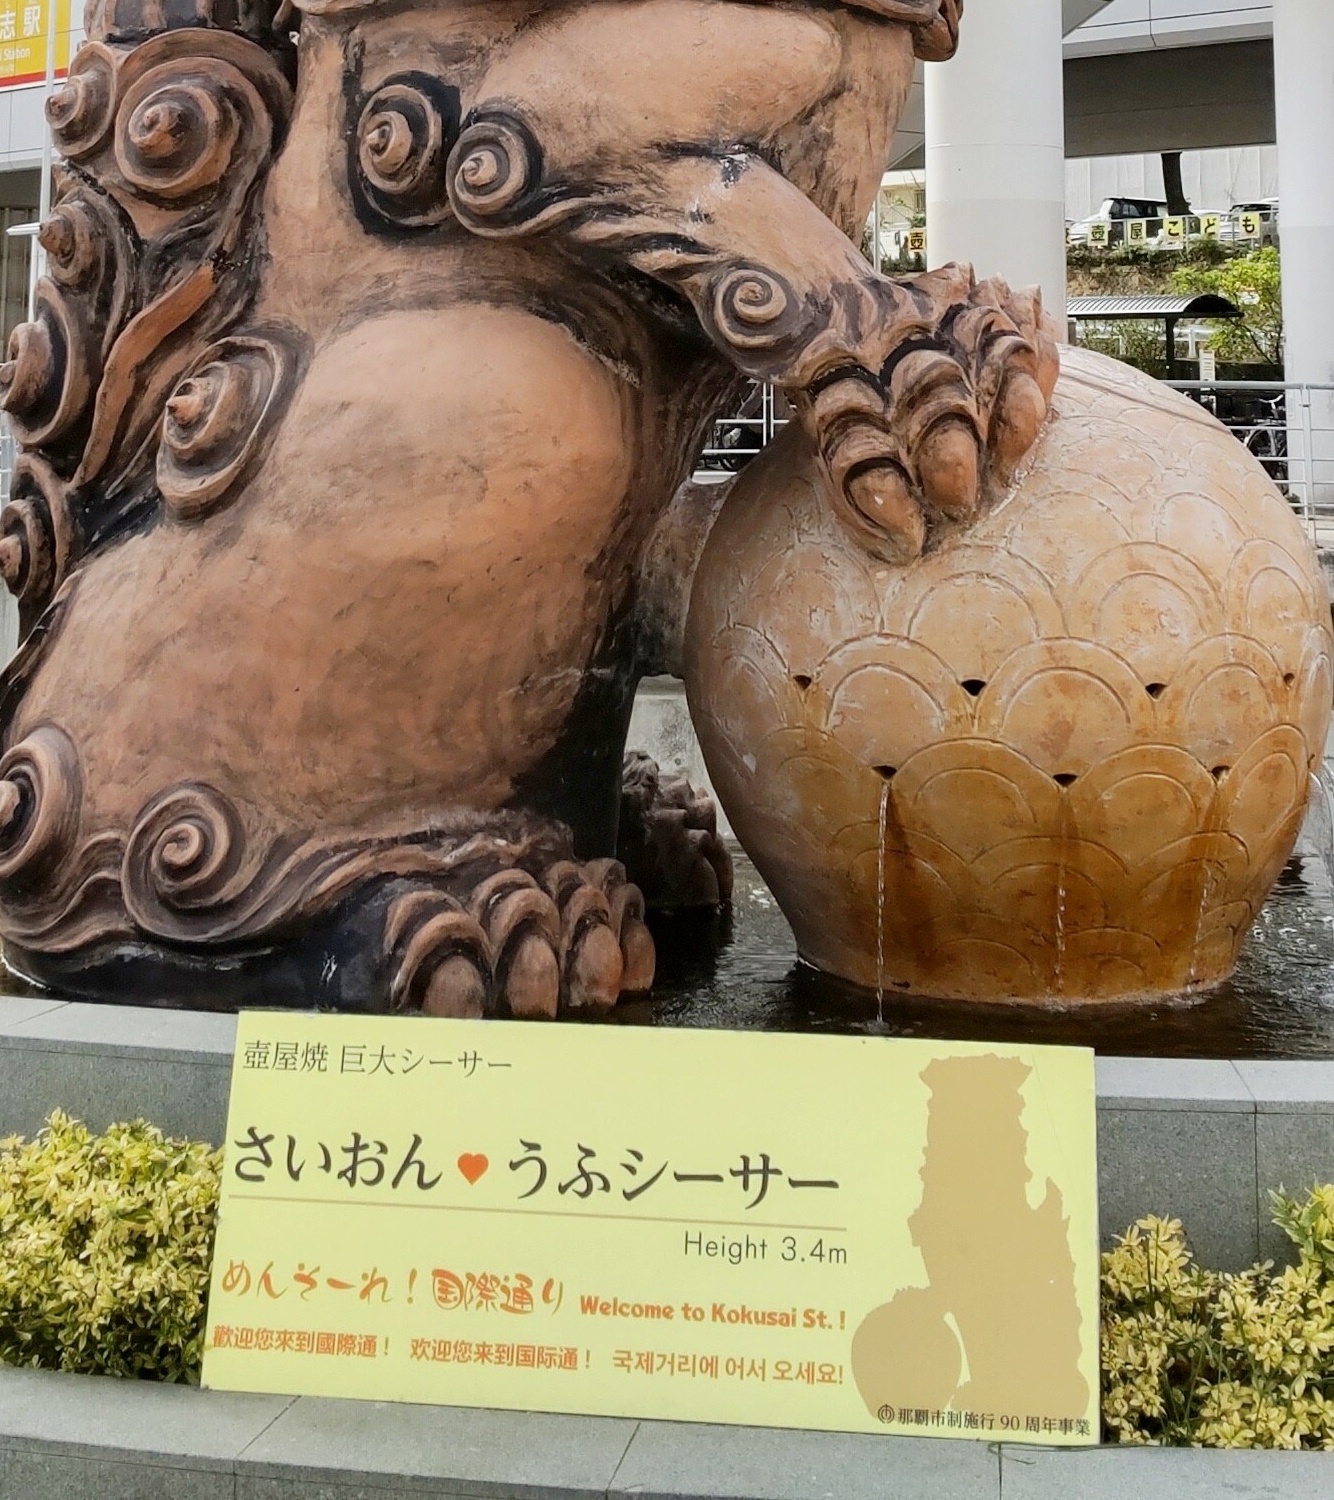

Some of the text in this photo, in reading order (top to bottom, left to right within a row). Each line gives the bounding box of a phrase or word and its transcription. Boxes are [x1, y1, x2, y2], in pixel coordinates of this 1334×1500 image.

[4, 47, 31, 63] Station
[340, 1044, 513, 1078] 巨大シーサー
[233, 1126, 841, 1210] さいおん うふシーサー
[683, 1230, 849, 1266] Height 3.4m
[579, 1294, 675, 1320] Welcome
[681, 1302, 705, 1322] to
[711, 1303, 797, 1328] Kokusai
[612, 1349, 844, 1385] 국제거리에 어서 오세요!
